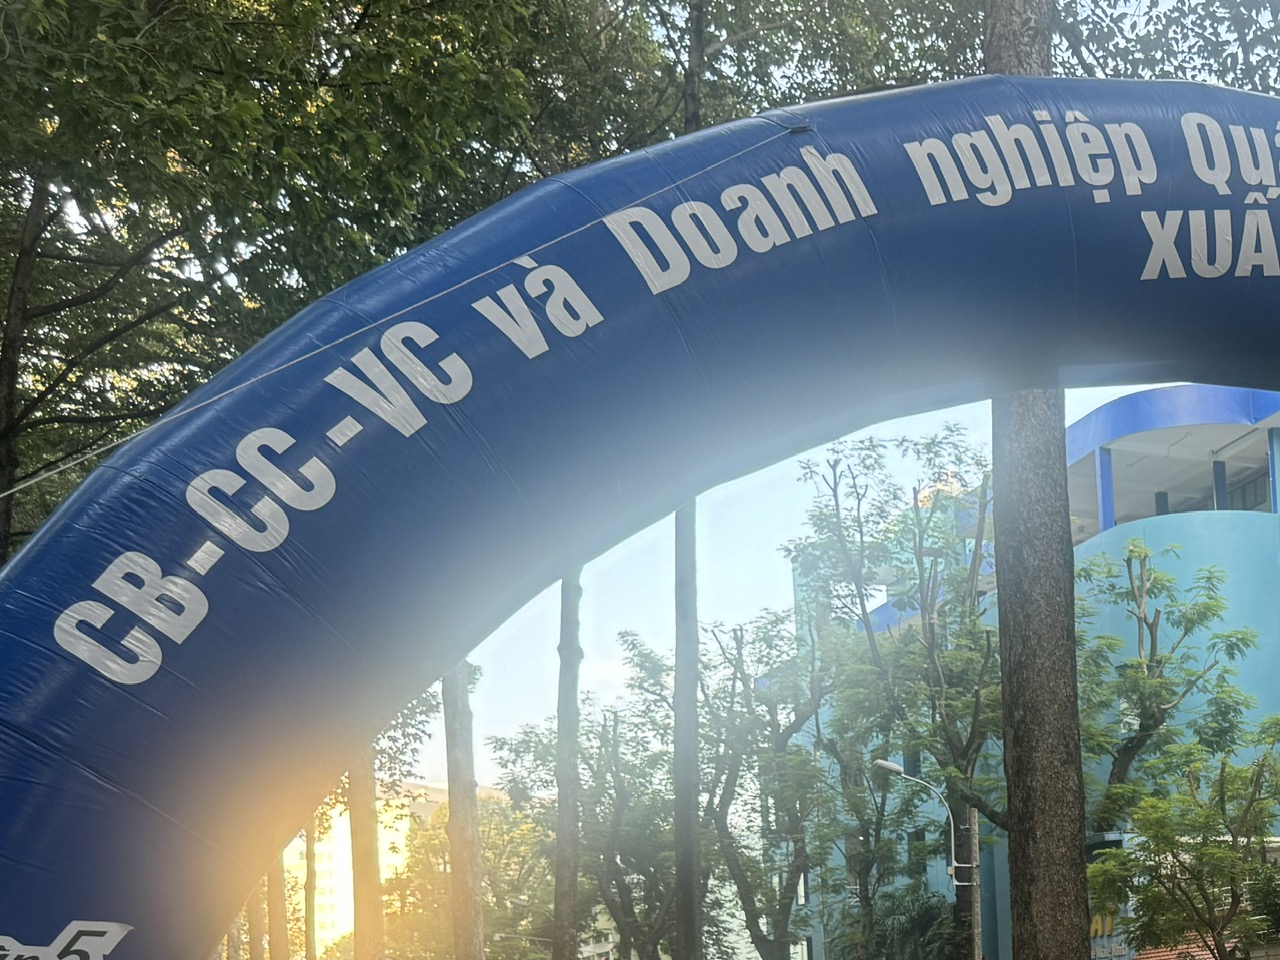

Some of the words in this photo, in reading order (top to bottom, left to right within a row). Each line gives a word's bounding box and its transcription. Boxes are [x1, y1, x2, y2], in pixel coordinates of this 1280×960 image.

[473, 254, 604, 358] và
[604, 144, 879, 295] Doanh
[904, 111, 1158, 206] nghiệp
